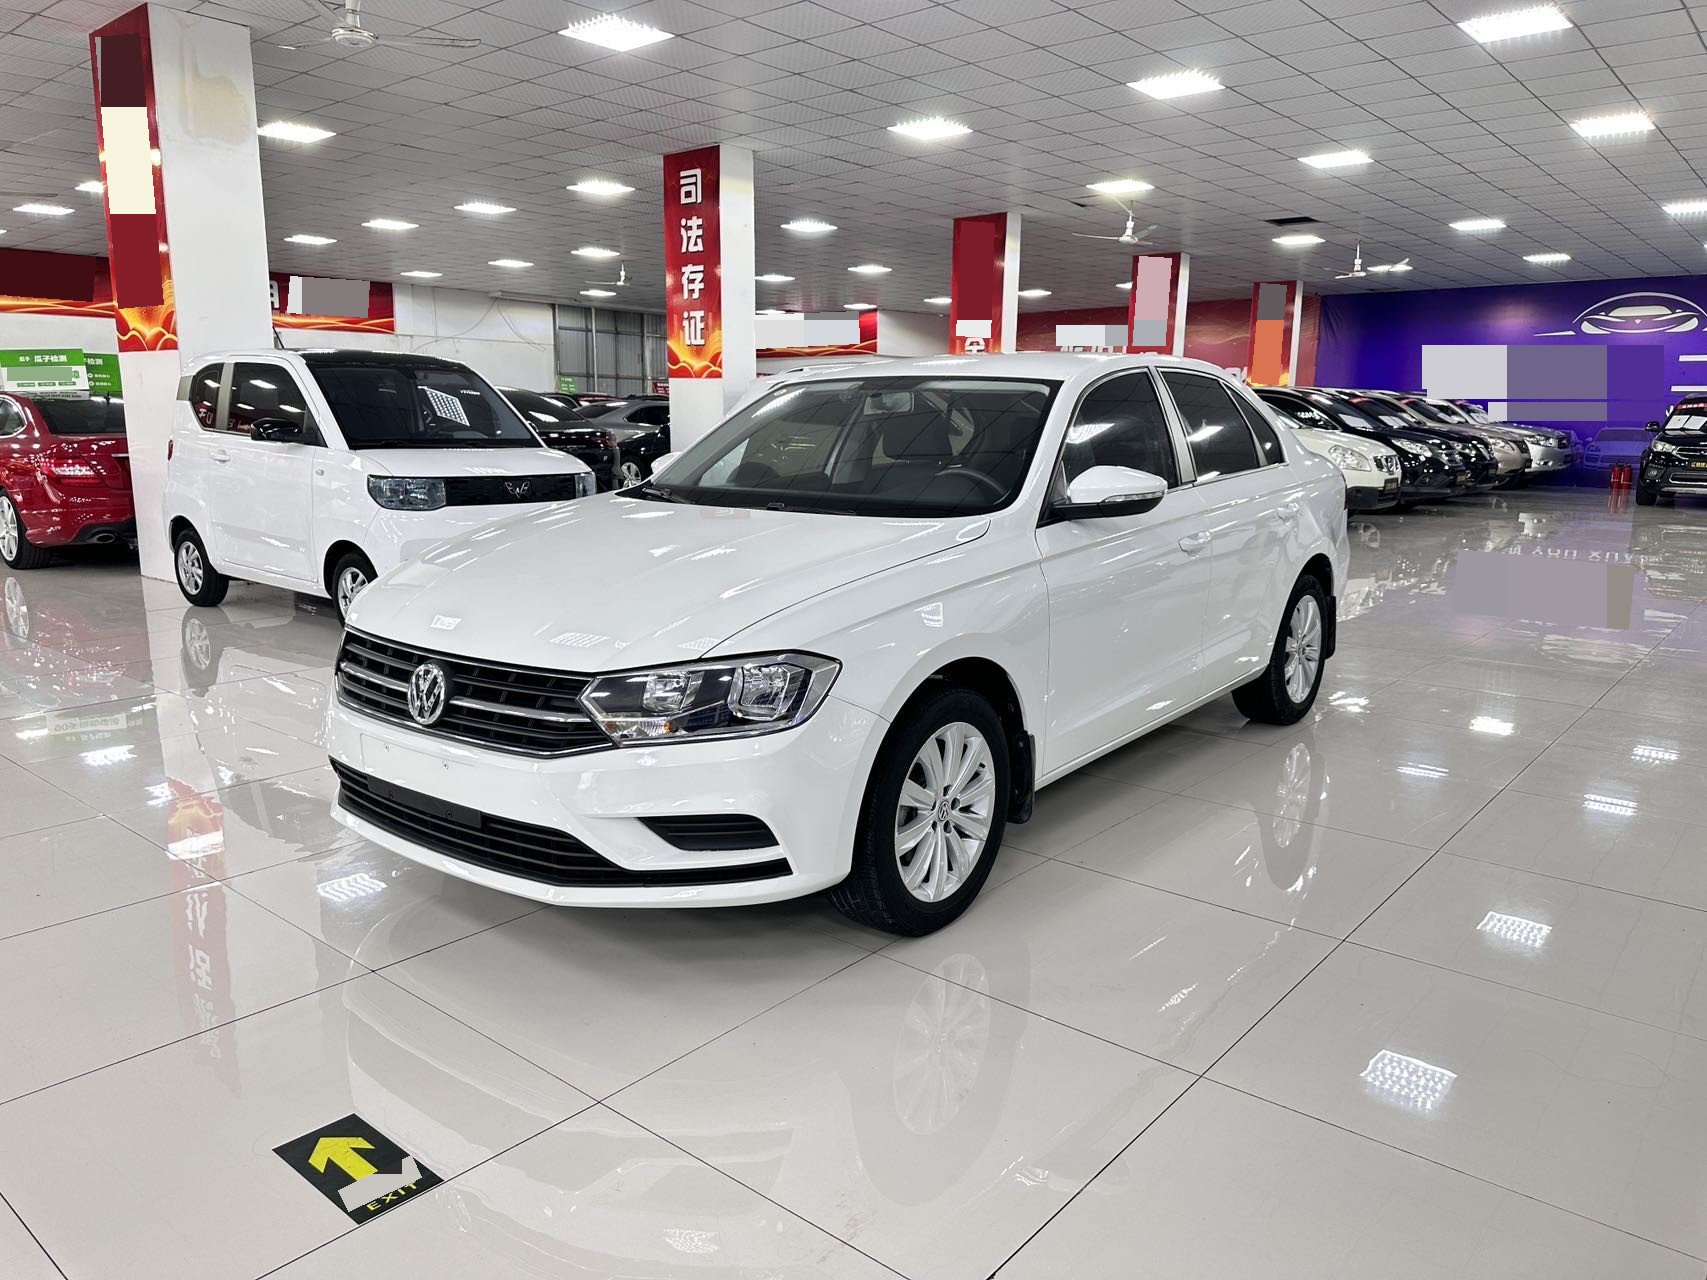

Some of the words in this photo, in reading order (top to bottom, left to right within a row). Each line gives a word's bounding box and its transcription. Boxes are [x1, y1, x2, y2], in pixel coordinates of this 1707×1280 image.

[679, 168, 706, 347] 司法存证
[34, 354, 67, 363] 瓜子检测
[366, 1182, 418, 1212] EXIT
